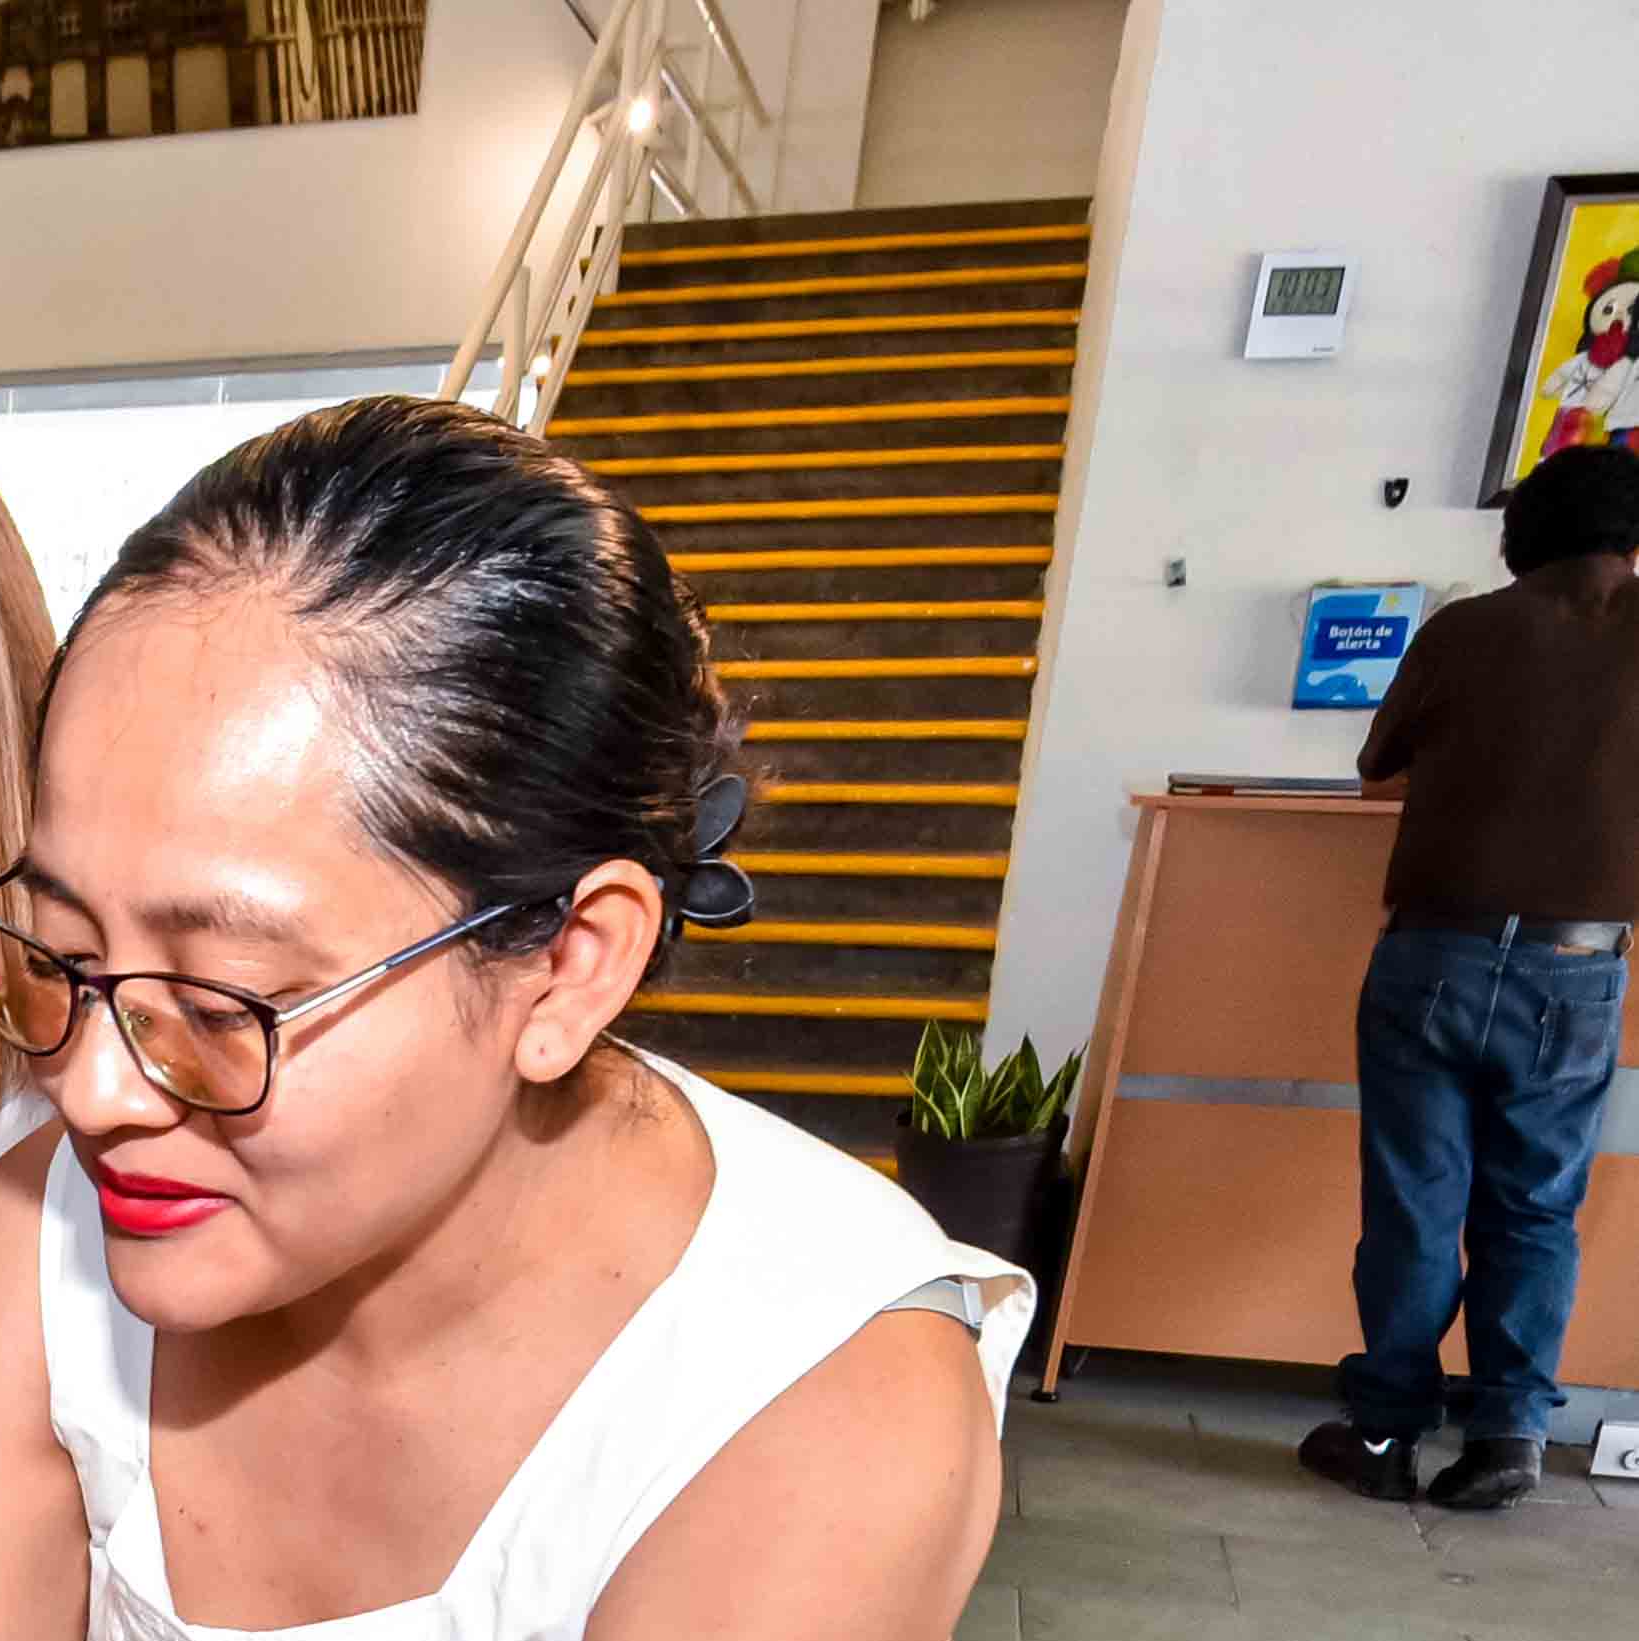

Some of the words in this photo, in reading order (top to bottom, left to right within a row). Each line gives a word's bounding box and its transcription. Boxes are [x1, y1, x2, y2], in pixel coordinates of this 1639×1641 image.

[1328, 623, 1372, 639] Botón
[1374, 624, 1394, 637] de
[1334, 636, 1382, 651] alerta
